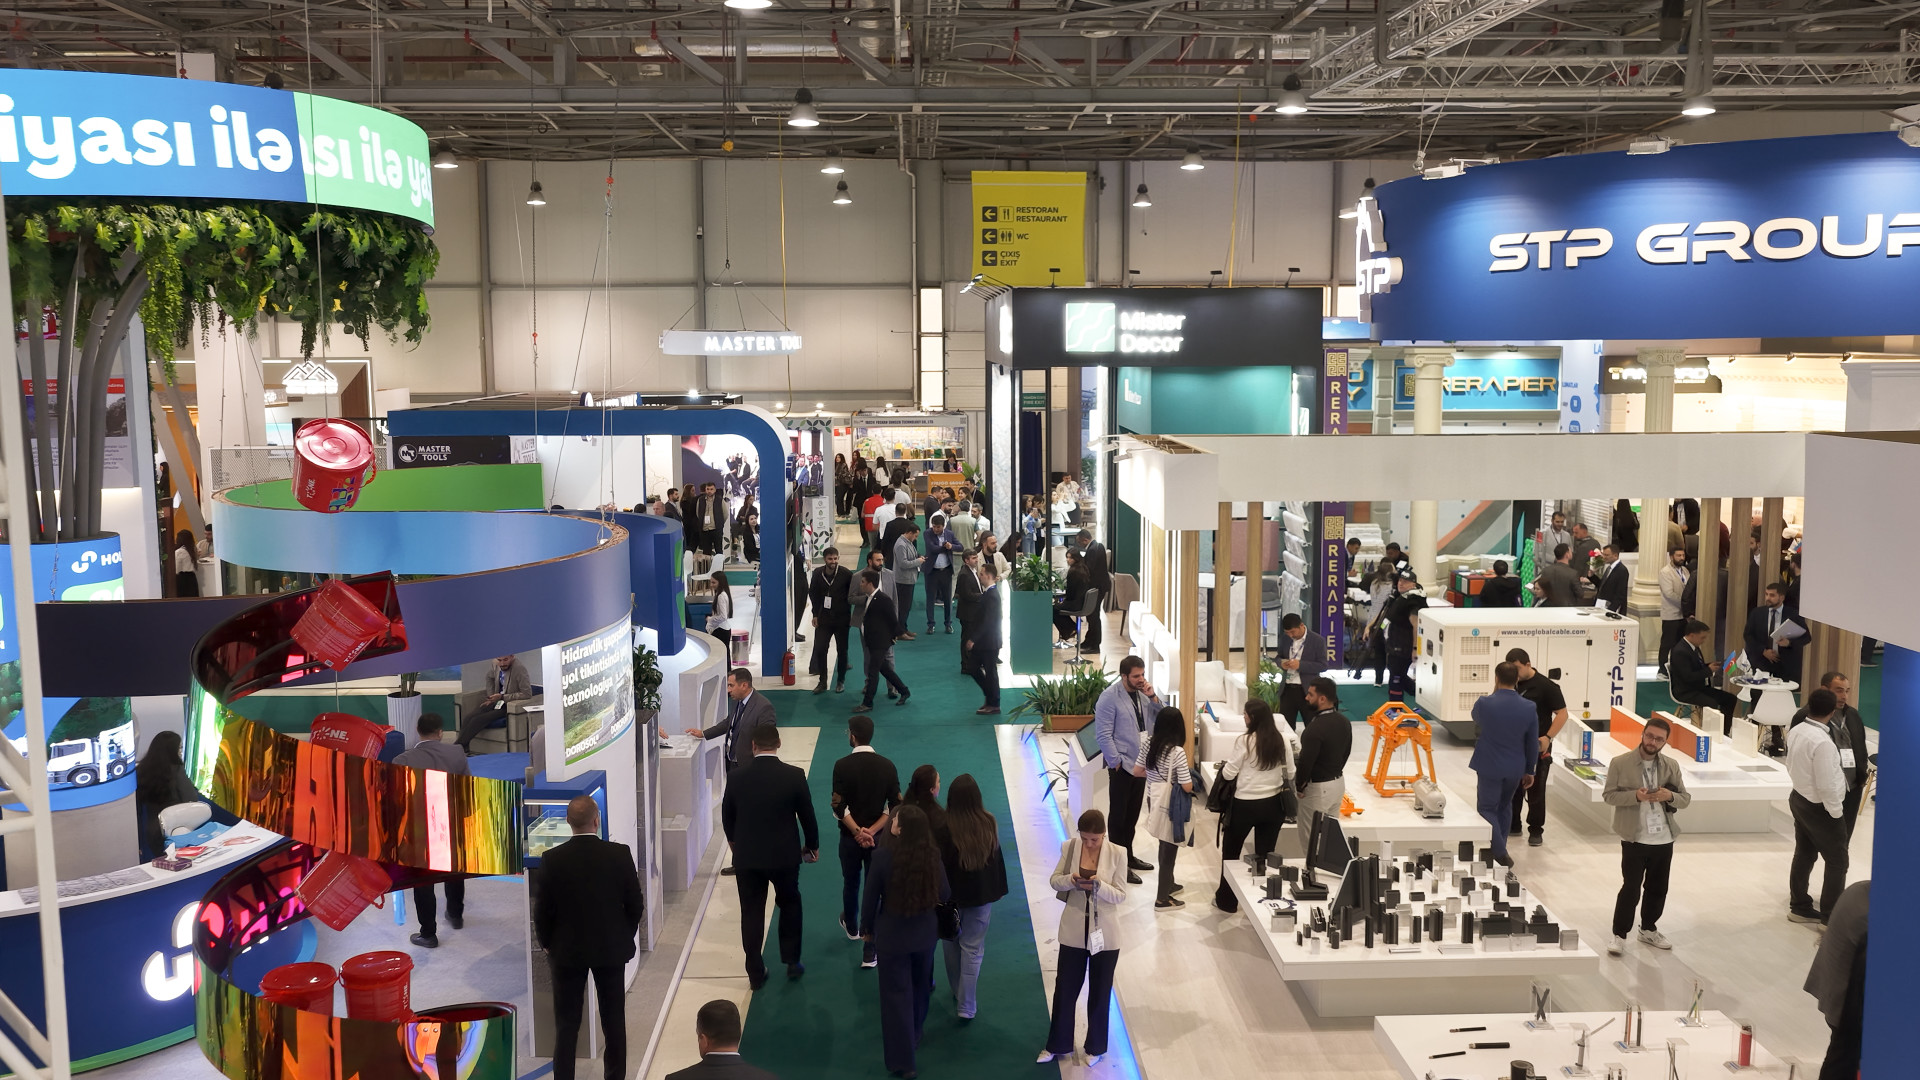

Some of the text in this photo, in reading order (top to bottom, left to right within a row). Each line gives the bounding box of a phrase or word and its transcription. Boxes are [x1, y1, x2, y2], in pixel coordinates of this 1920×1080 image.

[209, 104, 294, 173] ilə
[1016, 206, 1059, 214] RESTORAN
[1016, 215, 1068, 223] RESTAURANT
[1000, 250, 1021, 260] ÇIXIŞ
[1489, 227, 1614, 272] STP
[704, 336, 776, 352] MASTER
[1120, 333, 1184, 353] Decor
[418, 445, 451, 453] MASTER
[561, 638, 602, 665] Hidravlik
[562, 671, 578, 690] yol
[562, 676, 613, 707] texnologiya
